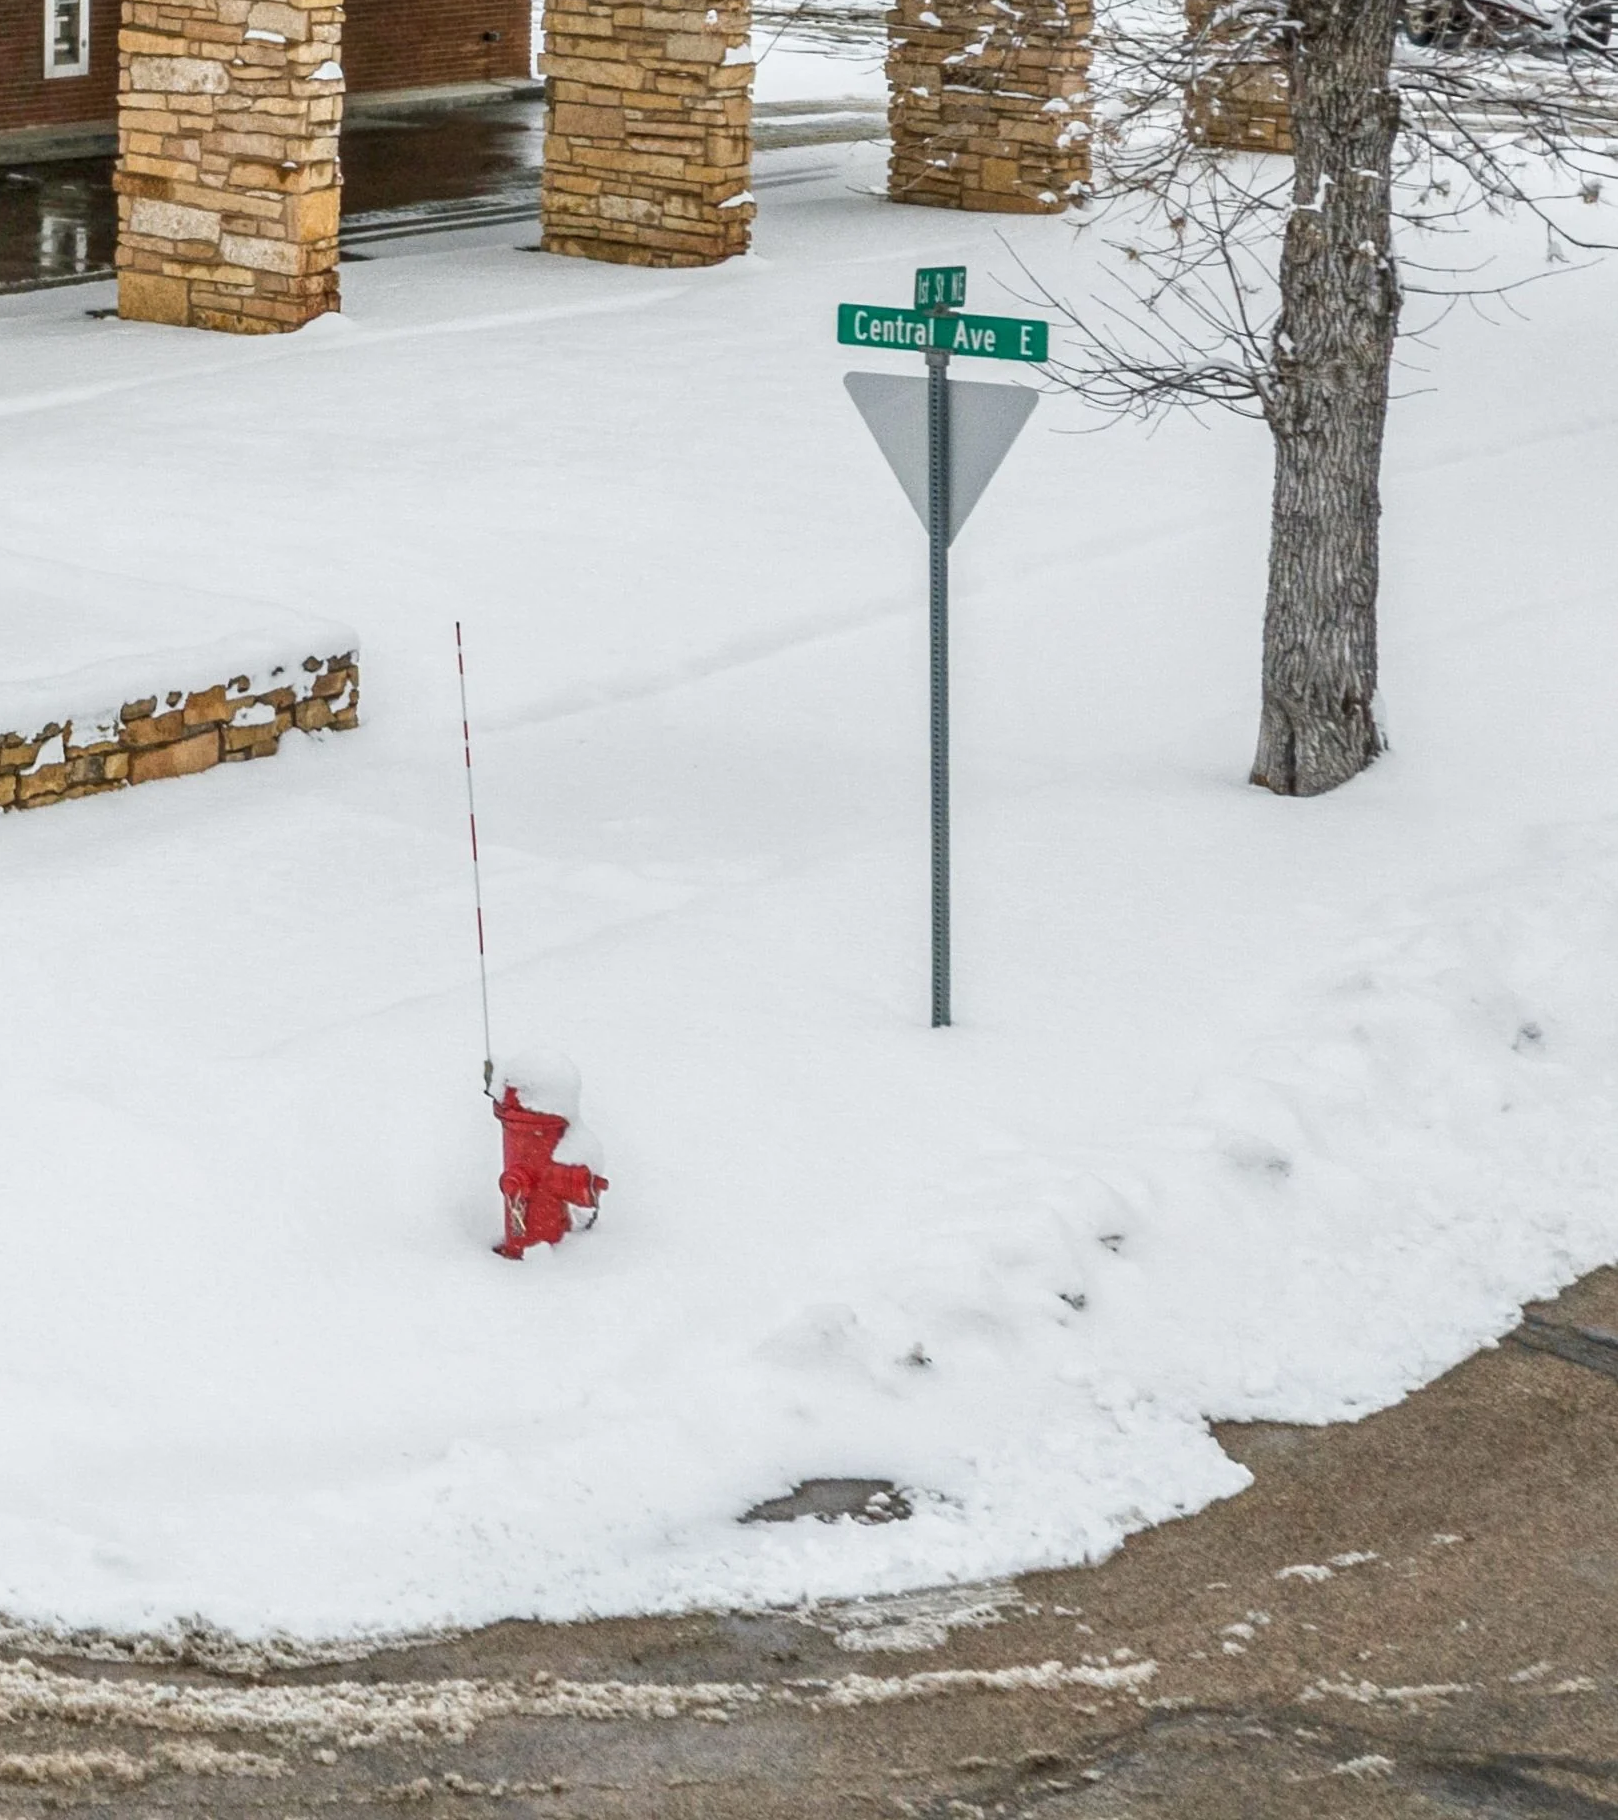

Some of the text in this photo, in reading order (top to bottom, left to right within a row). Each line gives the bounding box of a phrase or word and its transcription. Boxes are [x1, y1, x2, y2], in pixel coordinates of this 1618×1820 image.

[918, 272, 965, 304] 1st St NE
[854, 310, 1034, 356] Central Ave E
